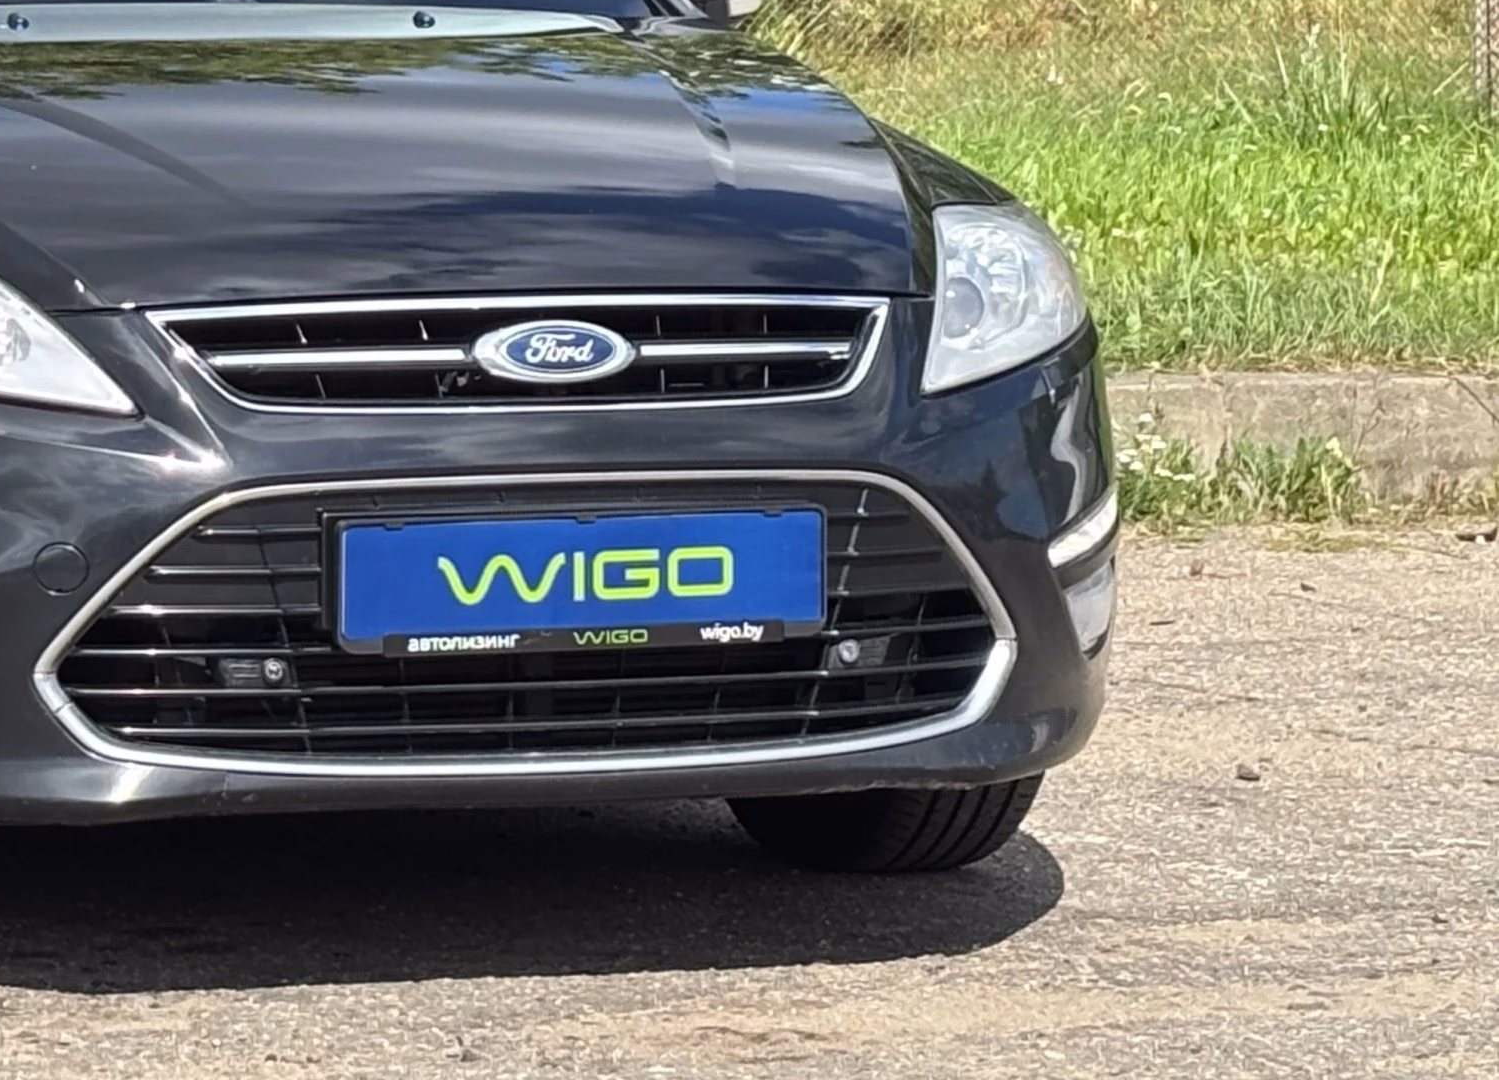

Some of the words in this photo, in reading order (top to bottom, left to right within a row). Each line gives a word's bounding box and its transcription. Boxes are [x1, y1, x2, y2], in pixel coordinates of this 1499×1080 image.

[525, 333, 594, 363] Ford
[437, 545, 734, 605] WIGO
[407, 632, 520, 652] автолизинг
[573, 628, 648, 646] WIGO
[700, 621, 763, 643] wigo.by
